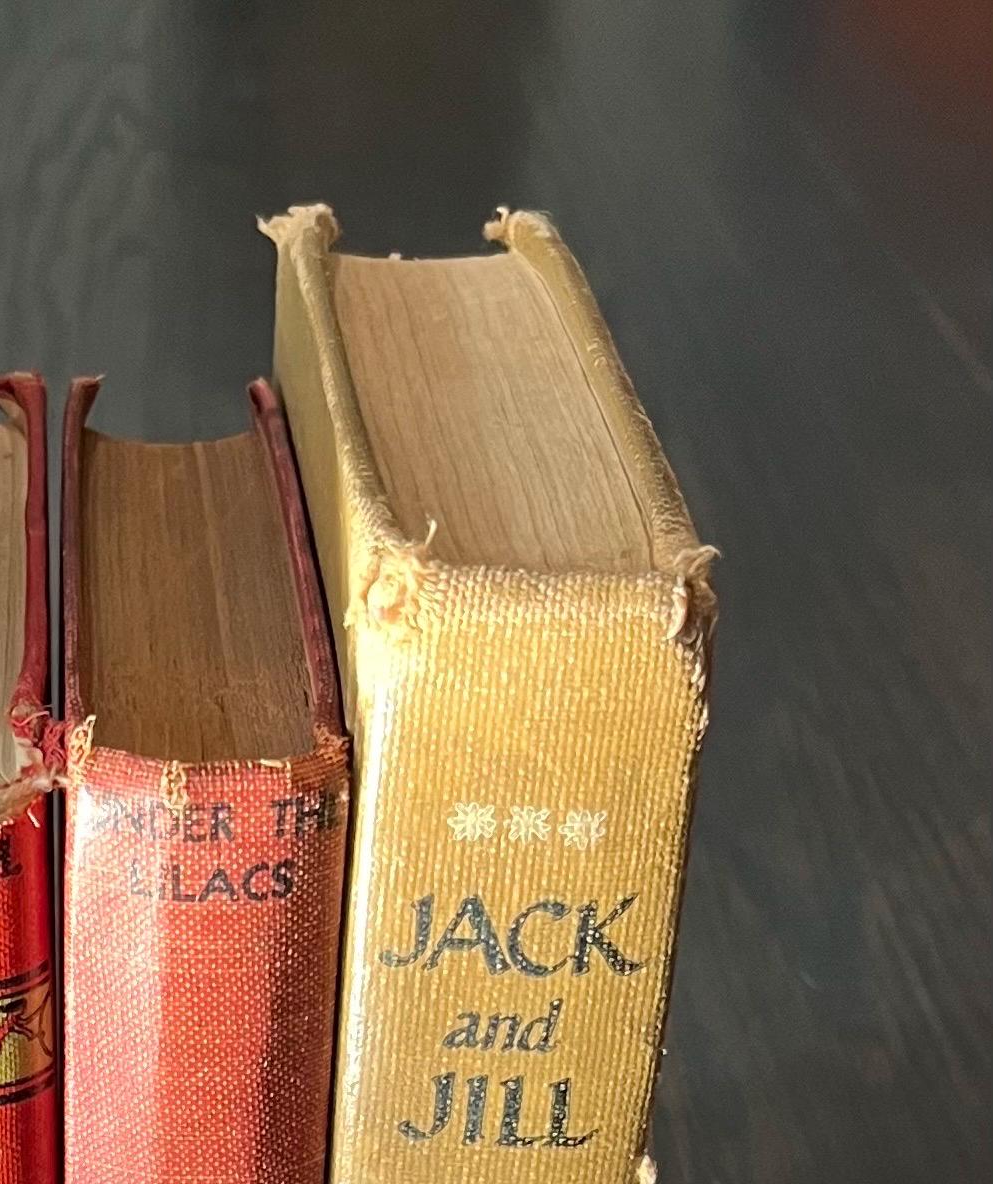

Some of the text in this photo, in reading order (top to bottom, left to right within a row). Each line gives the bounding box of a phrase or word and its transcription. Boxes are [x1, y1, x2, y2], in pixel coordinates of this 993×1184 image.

[378, 893, 645, 977] JACK
[441, 998, 561, 1051] and
[397, 1072, 600, 1147] JILL
